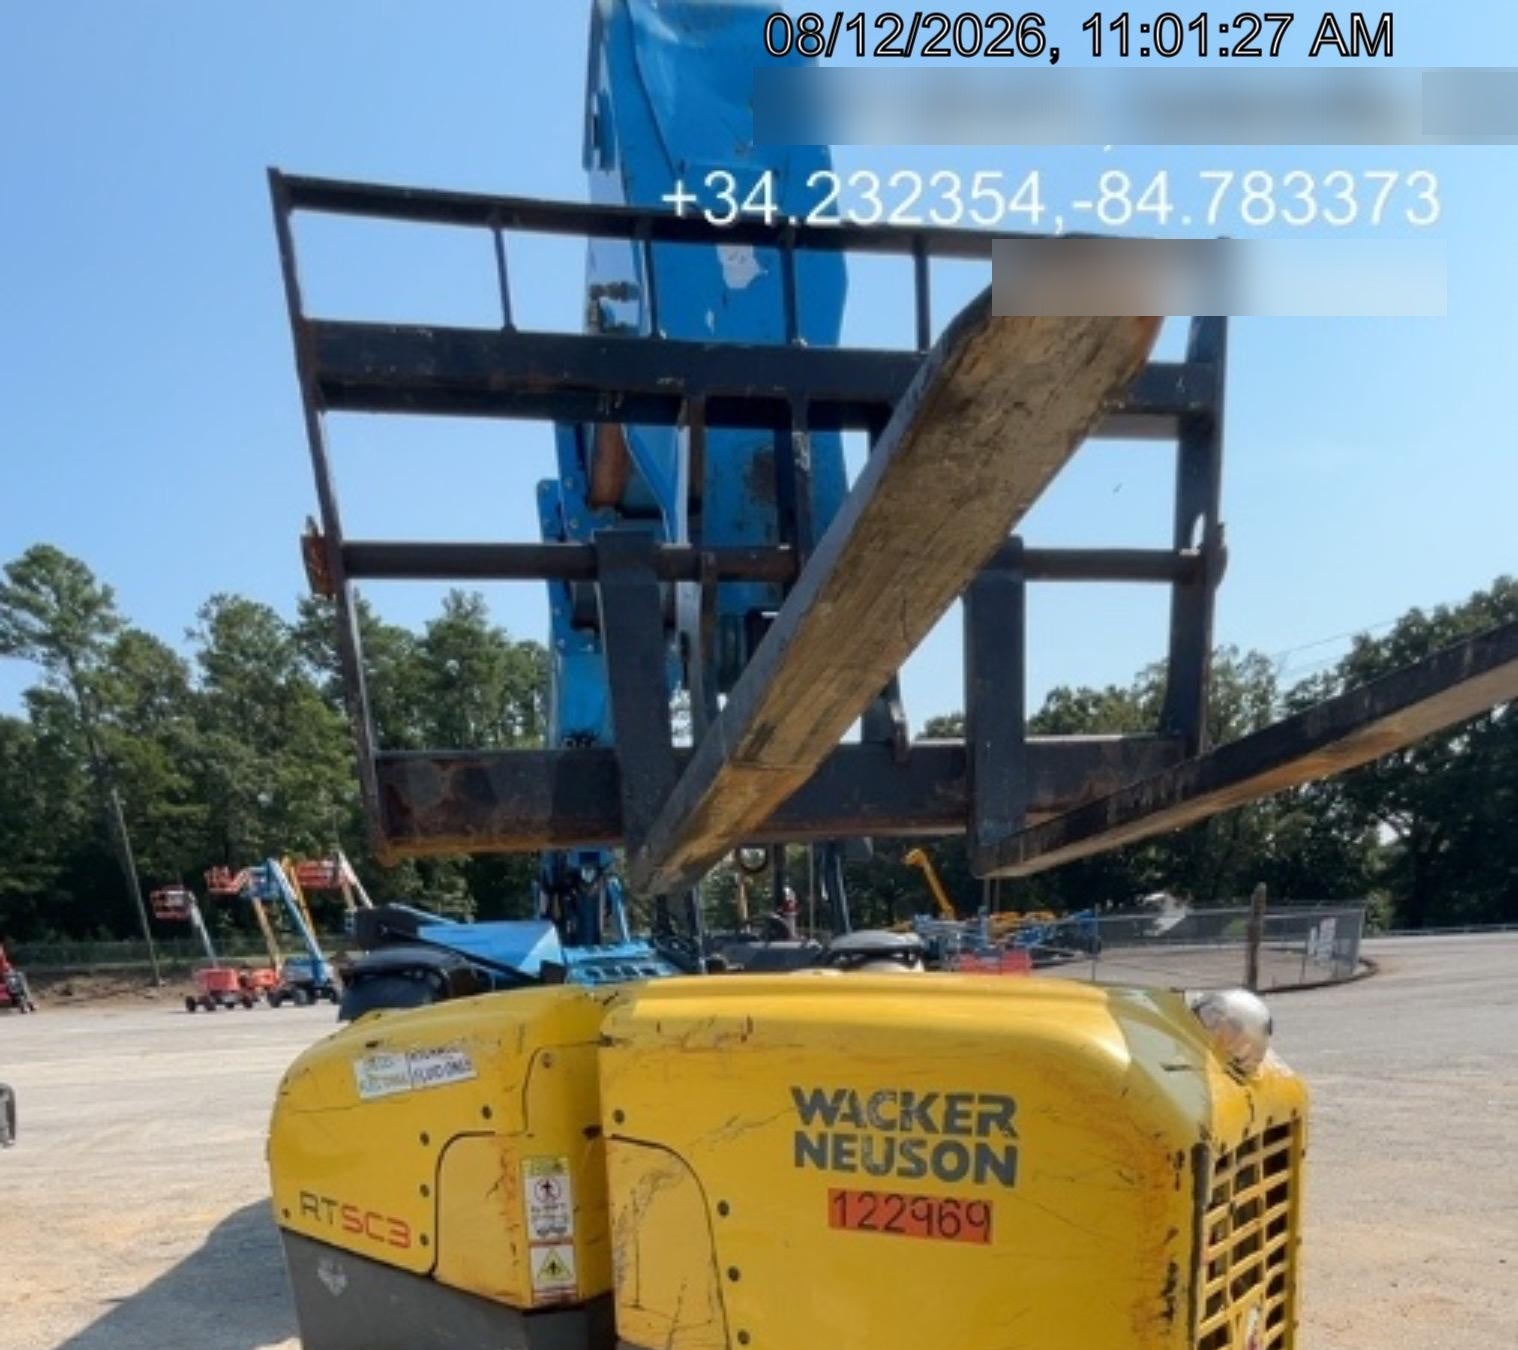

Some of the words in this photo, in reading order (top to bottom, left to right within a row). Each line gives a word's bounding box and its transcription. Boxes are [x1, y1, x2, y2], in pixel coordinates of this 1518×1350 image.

[790, 1086, 1019, 1139] WACKER
[794, 1131, 1018, 1188] NEUSON
[832, 1190, 992, 1243] 122969
